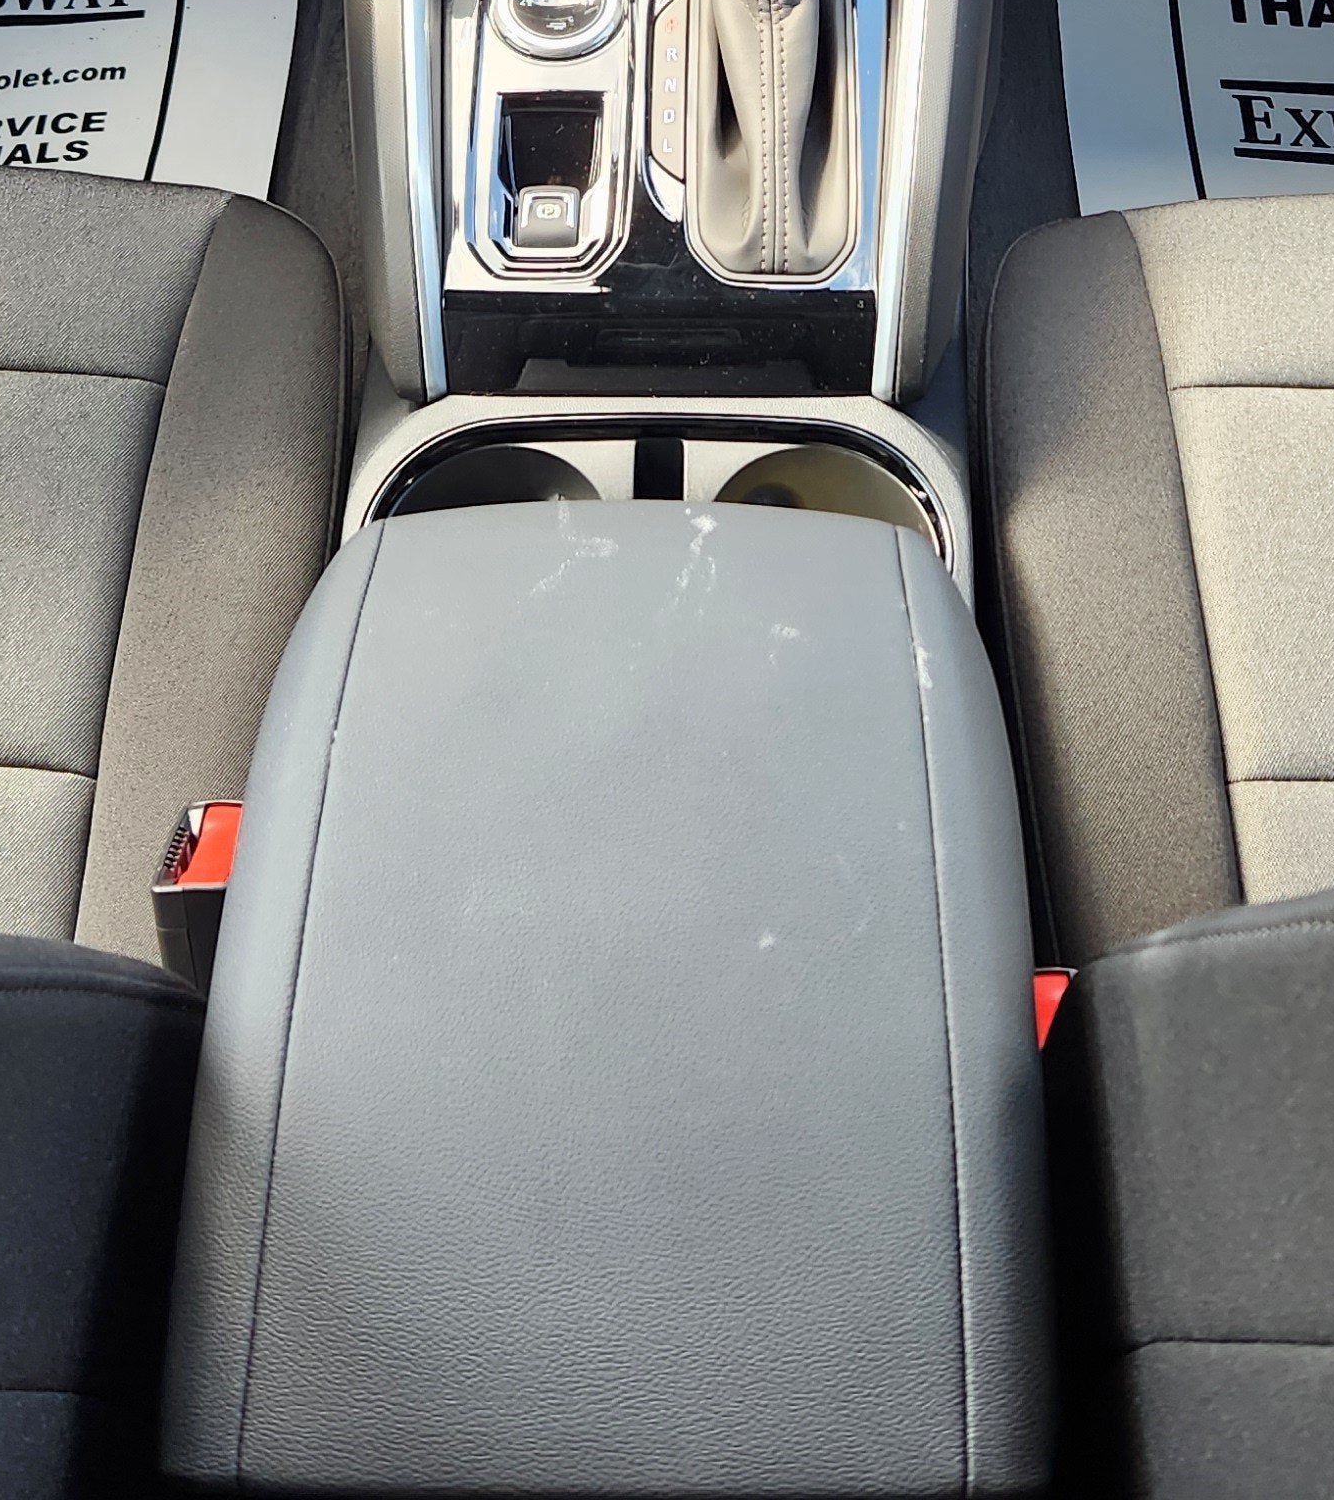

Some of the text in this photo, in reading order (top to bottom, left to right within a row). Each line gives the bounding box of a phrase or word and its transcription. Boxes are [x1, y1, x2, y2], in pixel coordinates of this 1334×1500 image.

[666, 47, 678, 62] R
[664, 78, 677, 92] N
[663, 109, 675, 124] D
[662, 138, 673, 153] L
